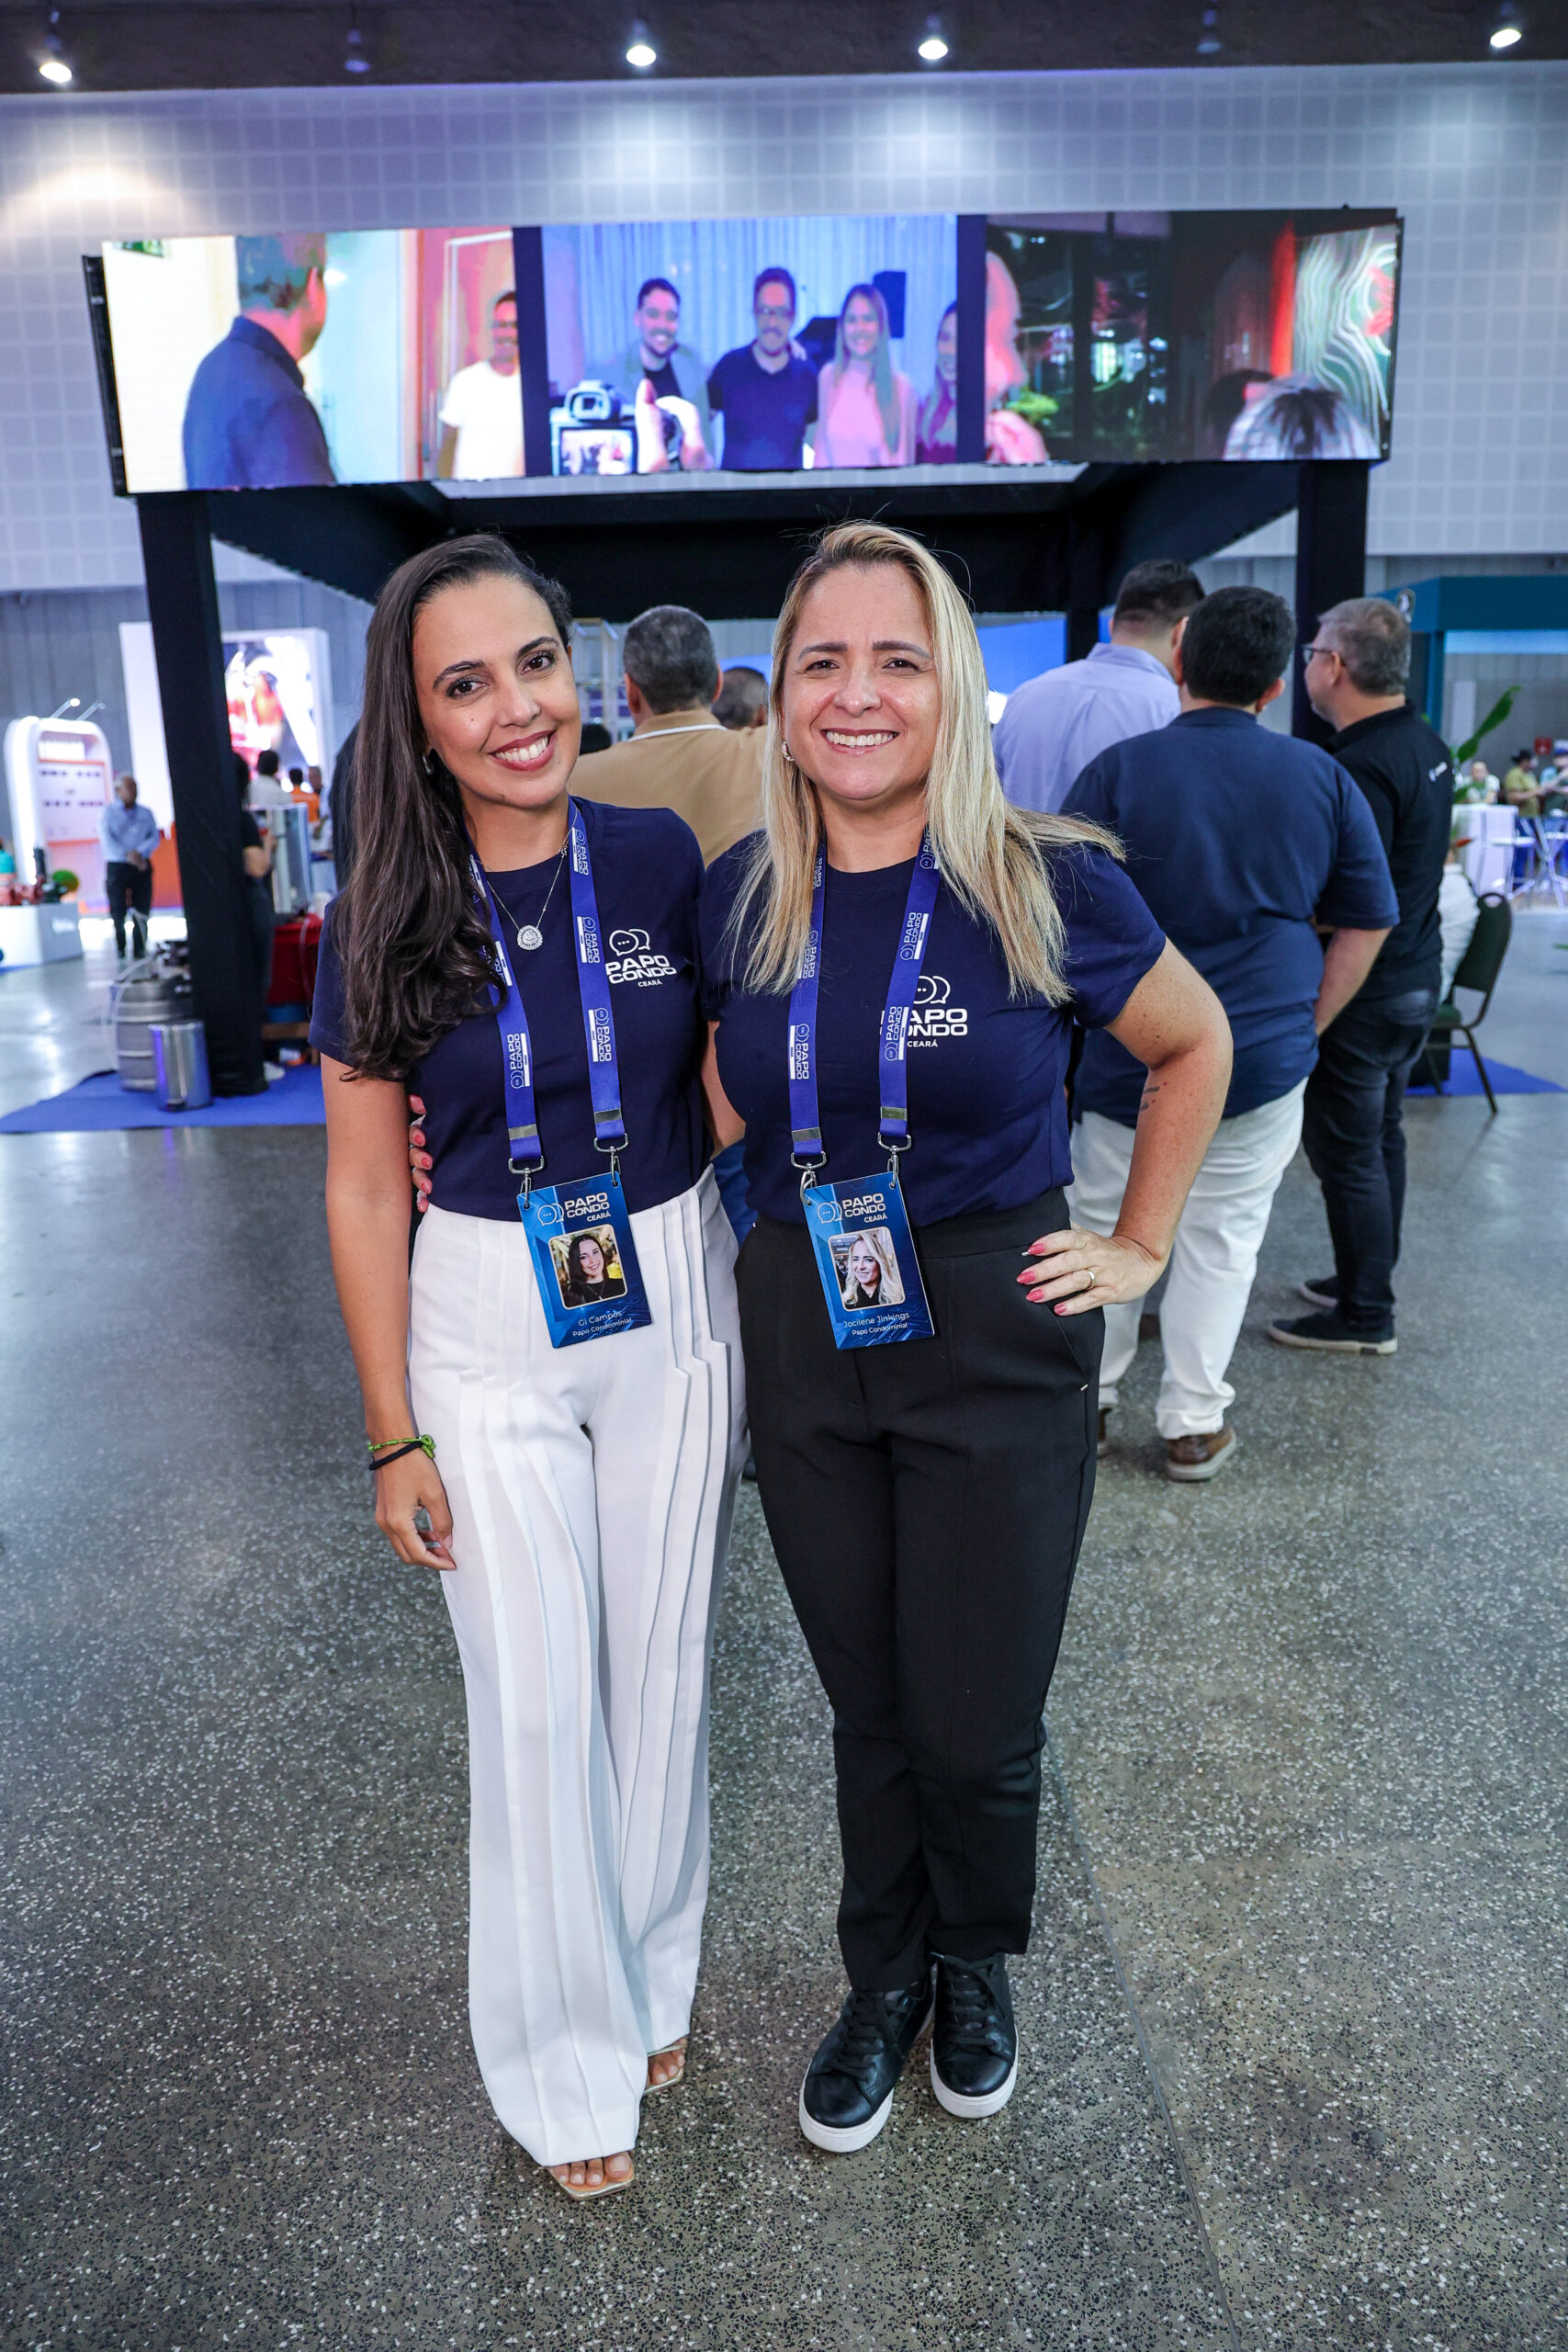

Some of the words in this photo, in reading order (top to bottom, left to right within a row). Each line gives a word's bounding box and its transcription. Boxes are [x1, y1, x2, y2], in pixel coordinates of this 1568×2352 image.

[581, 845, 589, 876] PAPO
[903, 911, 917, 944] PAPO
[910, 912, 922, 944] CONDO
[584, 933, 593, 964] CONDO
[590, 933, 600, 964] PAPO
[604, 955, 671, 976] PAPO
[808, 945, 817, 978] PAPO
[608, 967, 678, 985] CONDO
[637, 978, 663, 988] CEARÁ
[886, 1006, 897, 1041] PAPO
[893, 1006, 903, 1041] CONDO
[507, 1034, 517, 1070] PAPO
[514, 1033, 523, 1069] CONDO
[596, 1026, 605, 1062] CONDO
[603, 1025, 612, 1062] PAPO
[907, 1038, 939, 1047] CEARÁ
[801, 1042, 809, 1080] PAPO
[564, 1192, 608, 1211] PAPO
[566, 1201, 610, 1218] CONDO
[841, 1193, 885, 1210] PAPO
[844, 1203, 886, 1217] CONDO
[586, 1210, 612, 1222] CEARÁ
[863, 1213, 888, 1224] CEARÁ
[572, 1329, 590, 1337] Papo
[591, 1317, 632, 1332] Condominial
[589, 1311, 623, 1324] Campos
[842, 1317, 875, 1329] Jocilene
[868, 1322, 908, 1333] Condominial
